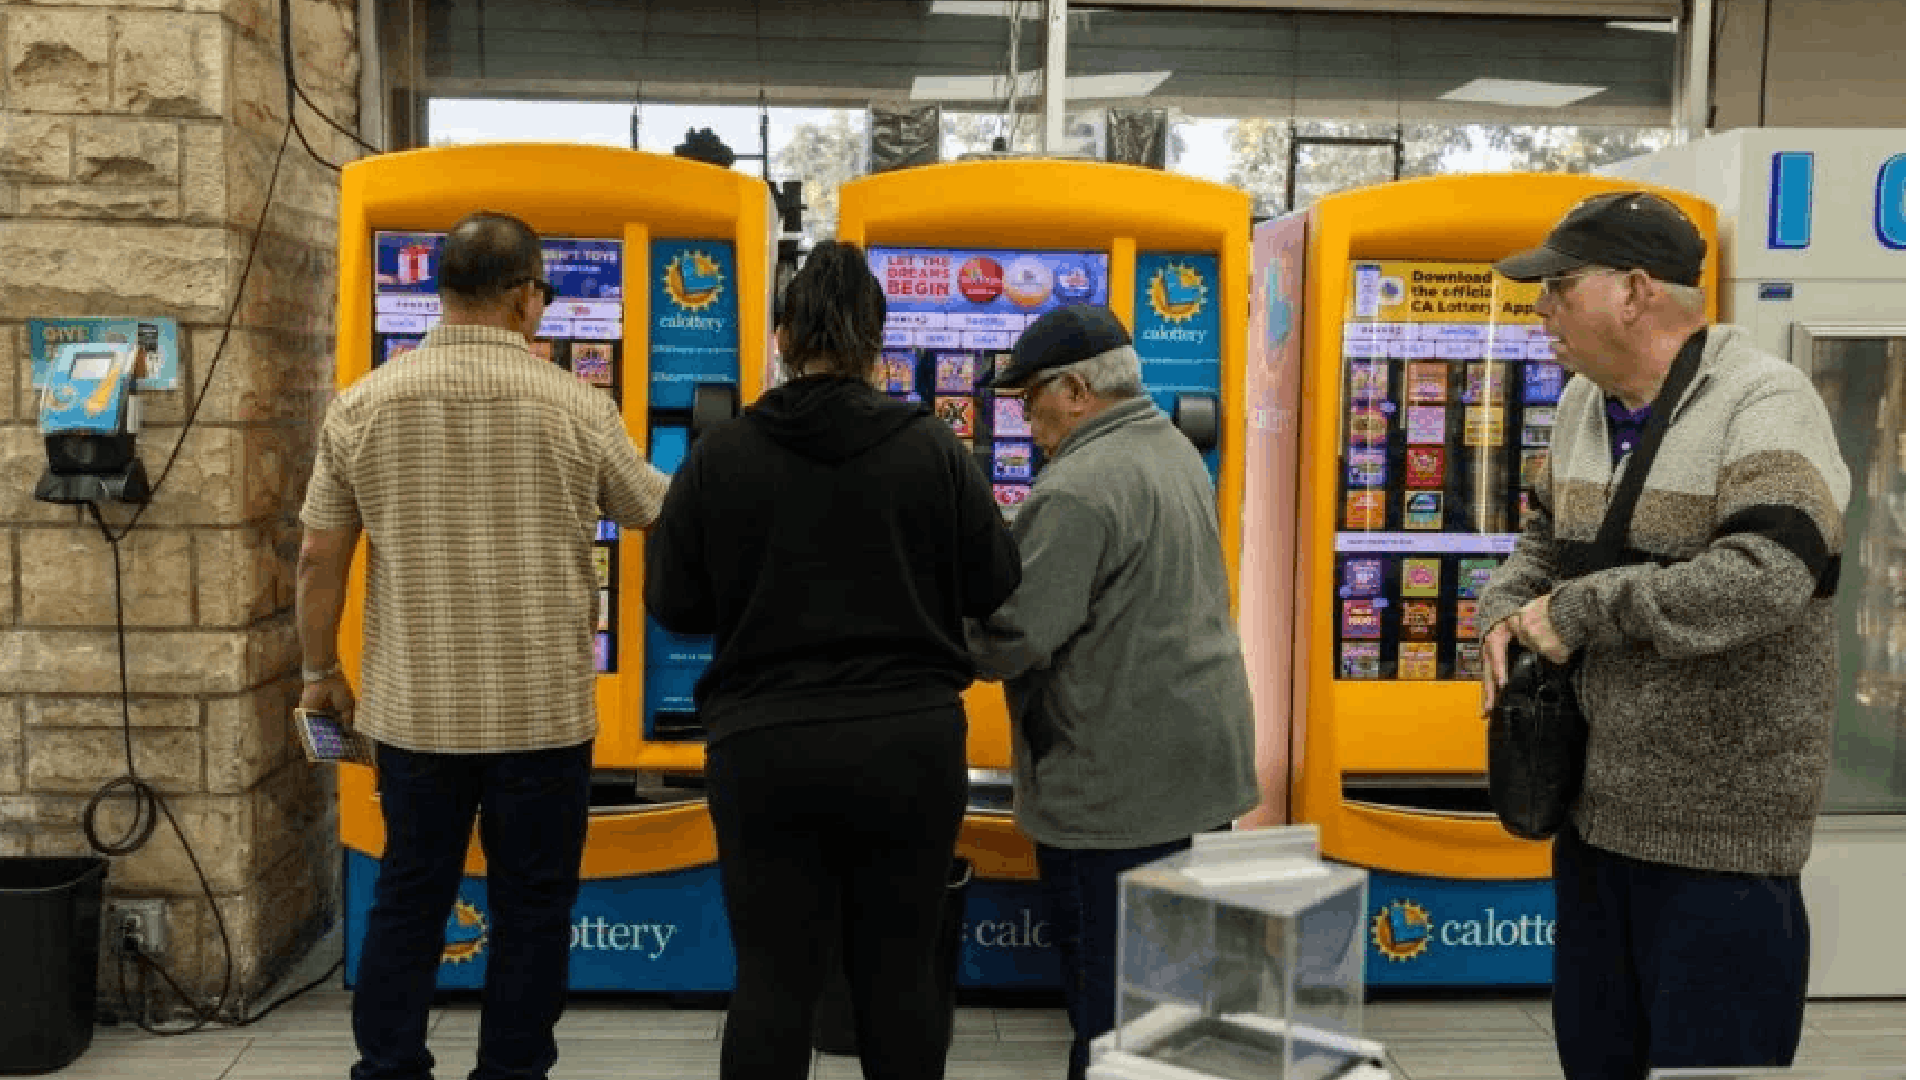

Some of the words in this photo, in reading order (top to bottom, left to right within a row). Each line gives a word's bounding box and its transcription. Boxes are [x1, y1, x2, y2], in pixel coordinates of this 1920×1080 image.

[887, 255, 913, 266] LET
[920, 255, 950, 266] THE
[887, 267, 950, 279] DREAMS
[1411, 269, 1493, 283] Download
[887, 280, 950, 295] BEGIN
[1411, 284, 1438, 297] the
[1442, 284, 1494, 297] officia
[1411, 301, 1434, 313] CA
[1437, 301, 1492, 316] Lottery
